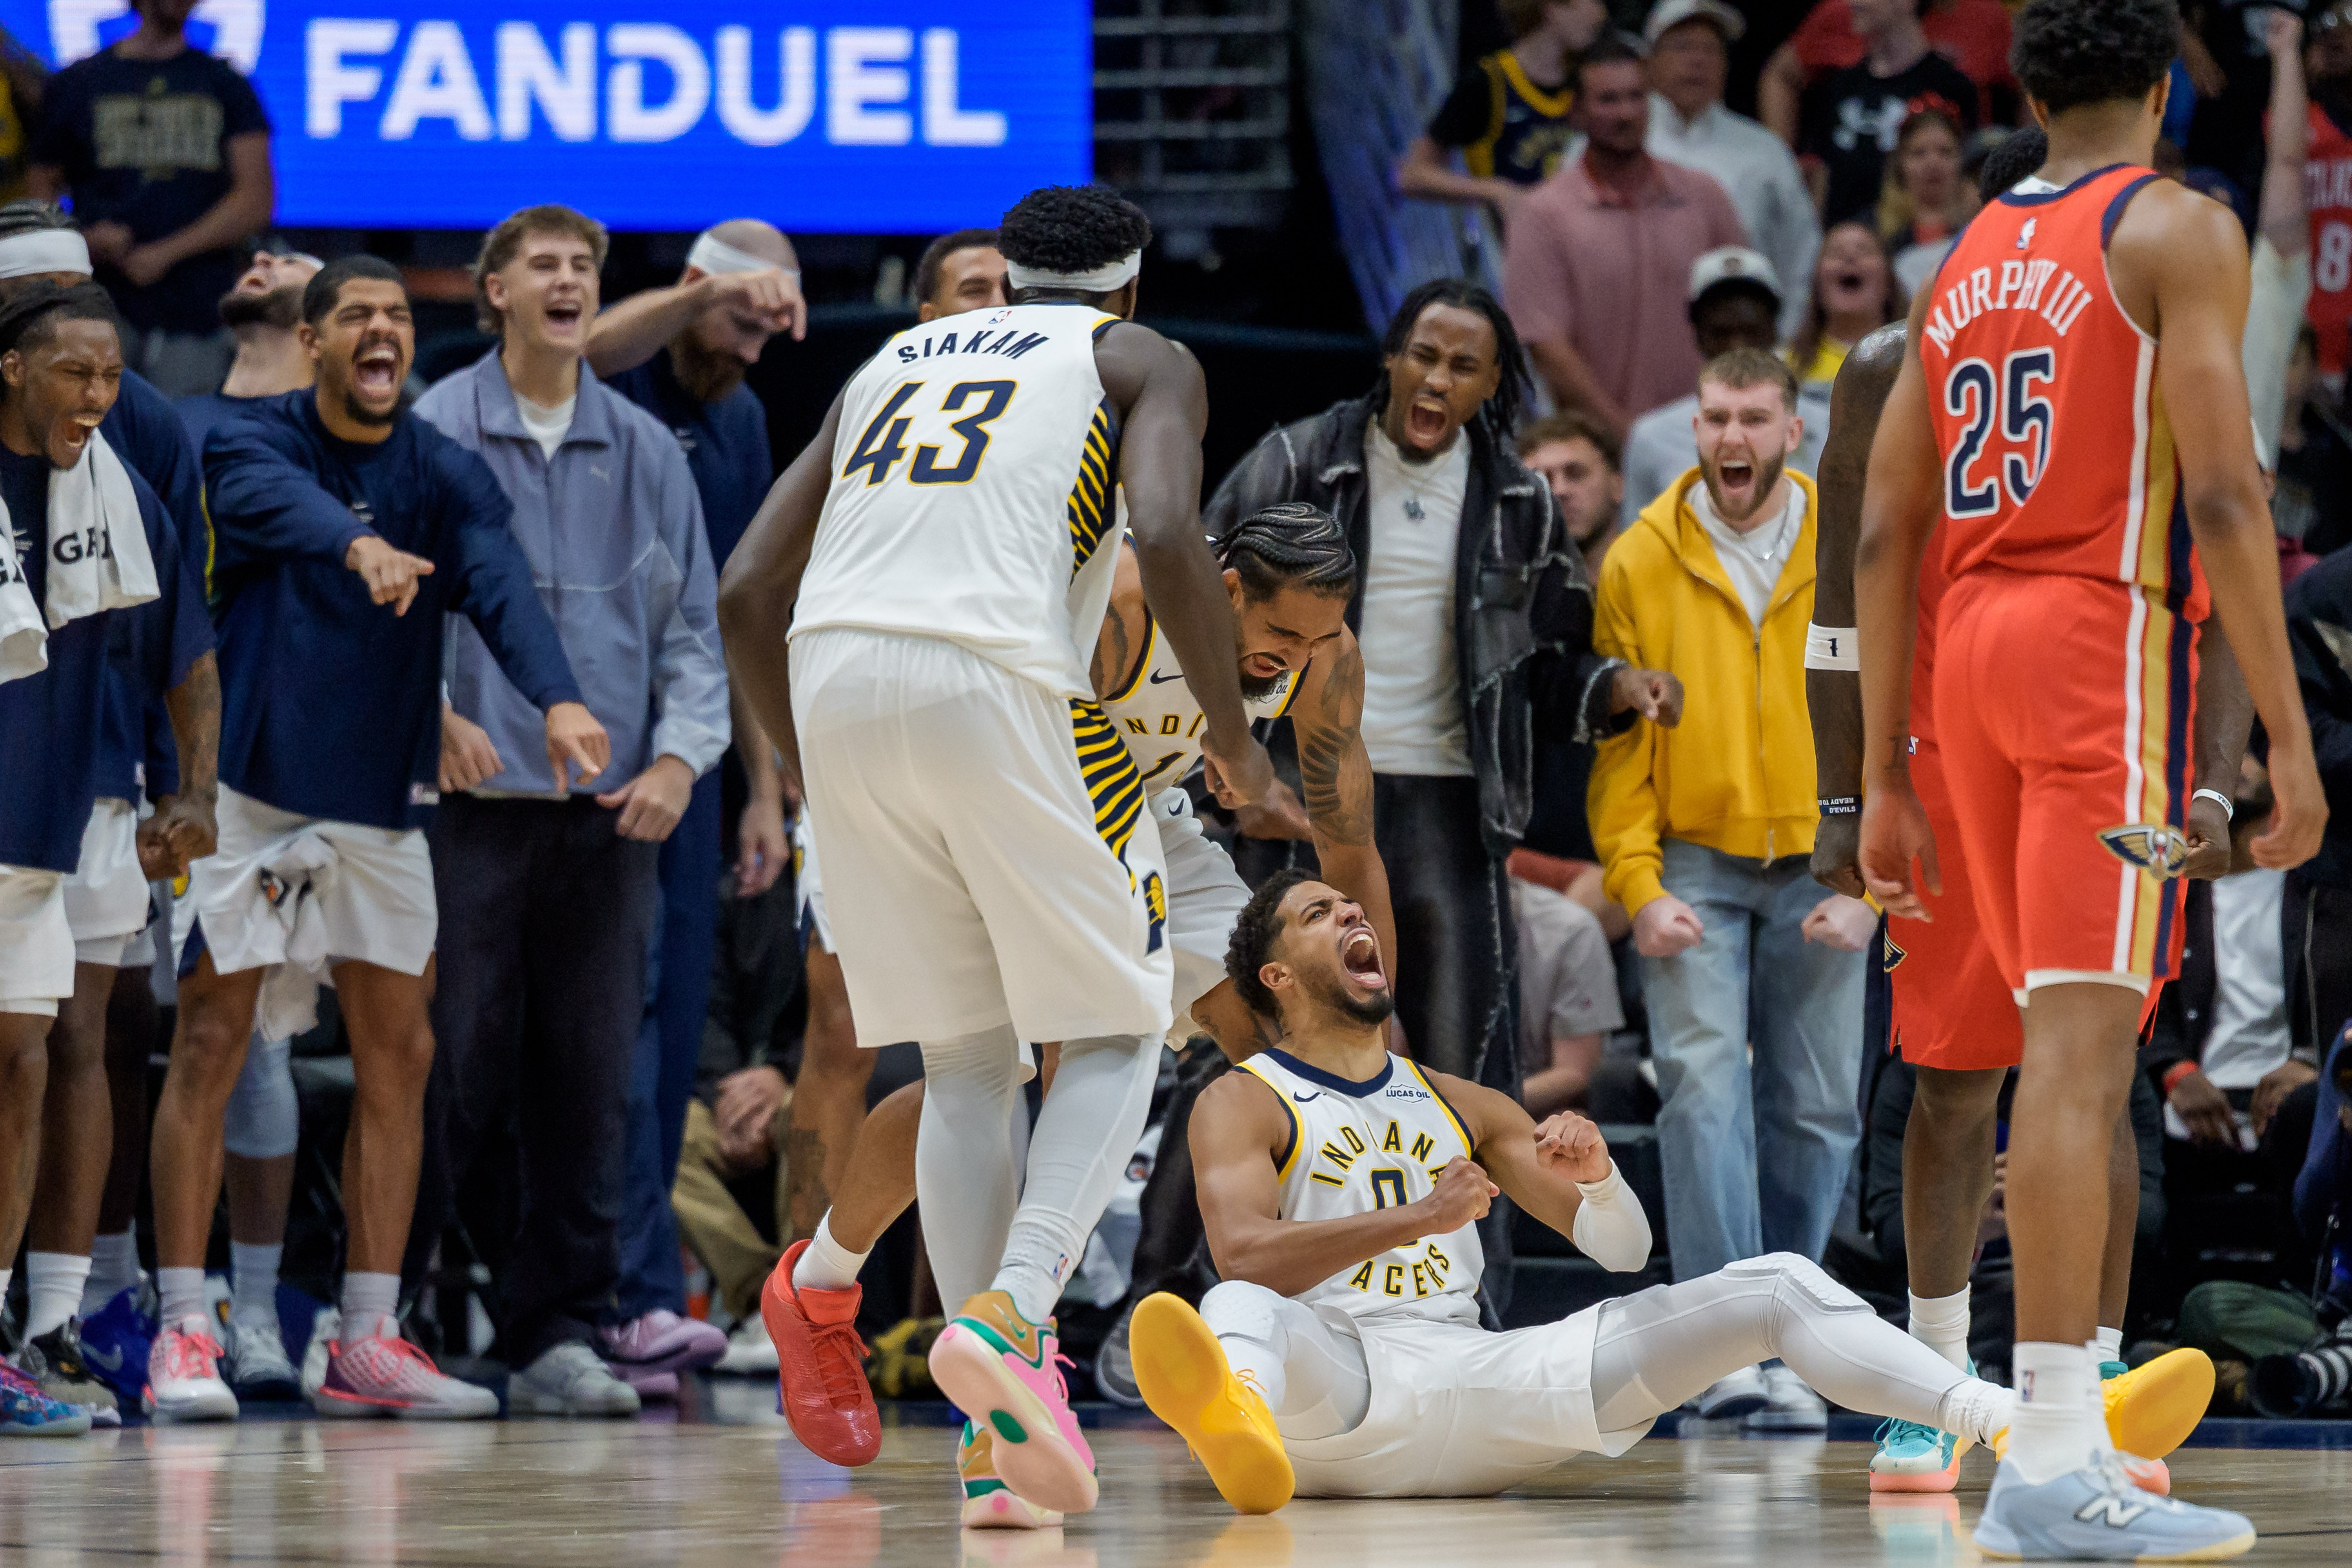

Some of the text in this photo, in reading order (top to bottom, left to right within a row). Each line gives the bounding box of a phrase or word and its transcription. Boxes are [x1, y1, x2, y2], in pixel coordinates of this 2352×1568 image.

[305, 18, 1008, 146] FANDUEL
[1925, 259, 2058, 358] MURPHY
[898, 330, 1050, 363] SIAKAM
[840, 379, 1019, 488] 43
[1944, 346, 2056, 519] 25
[1827, 638, 1838, 657] 1
[1122, 712, 1205, 739] NDI
[1310, 1120, 1448, 1189] INDAN
[1348, 1242, 1450, 1298] ACERS
